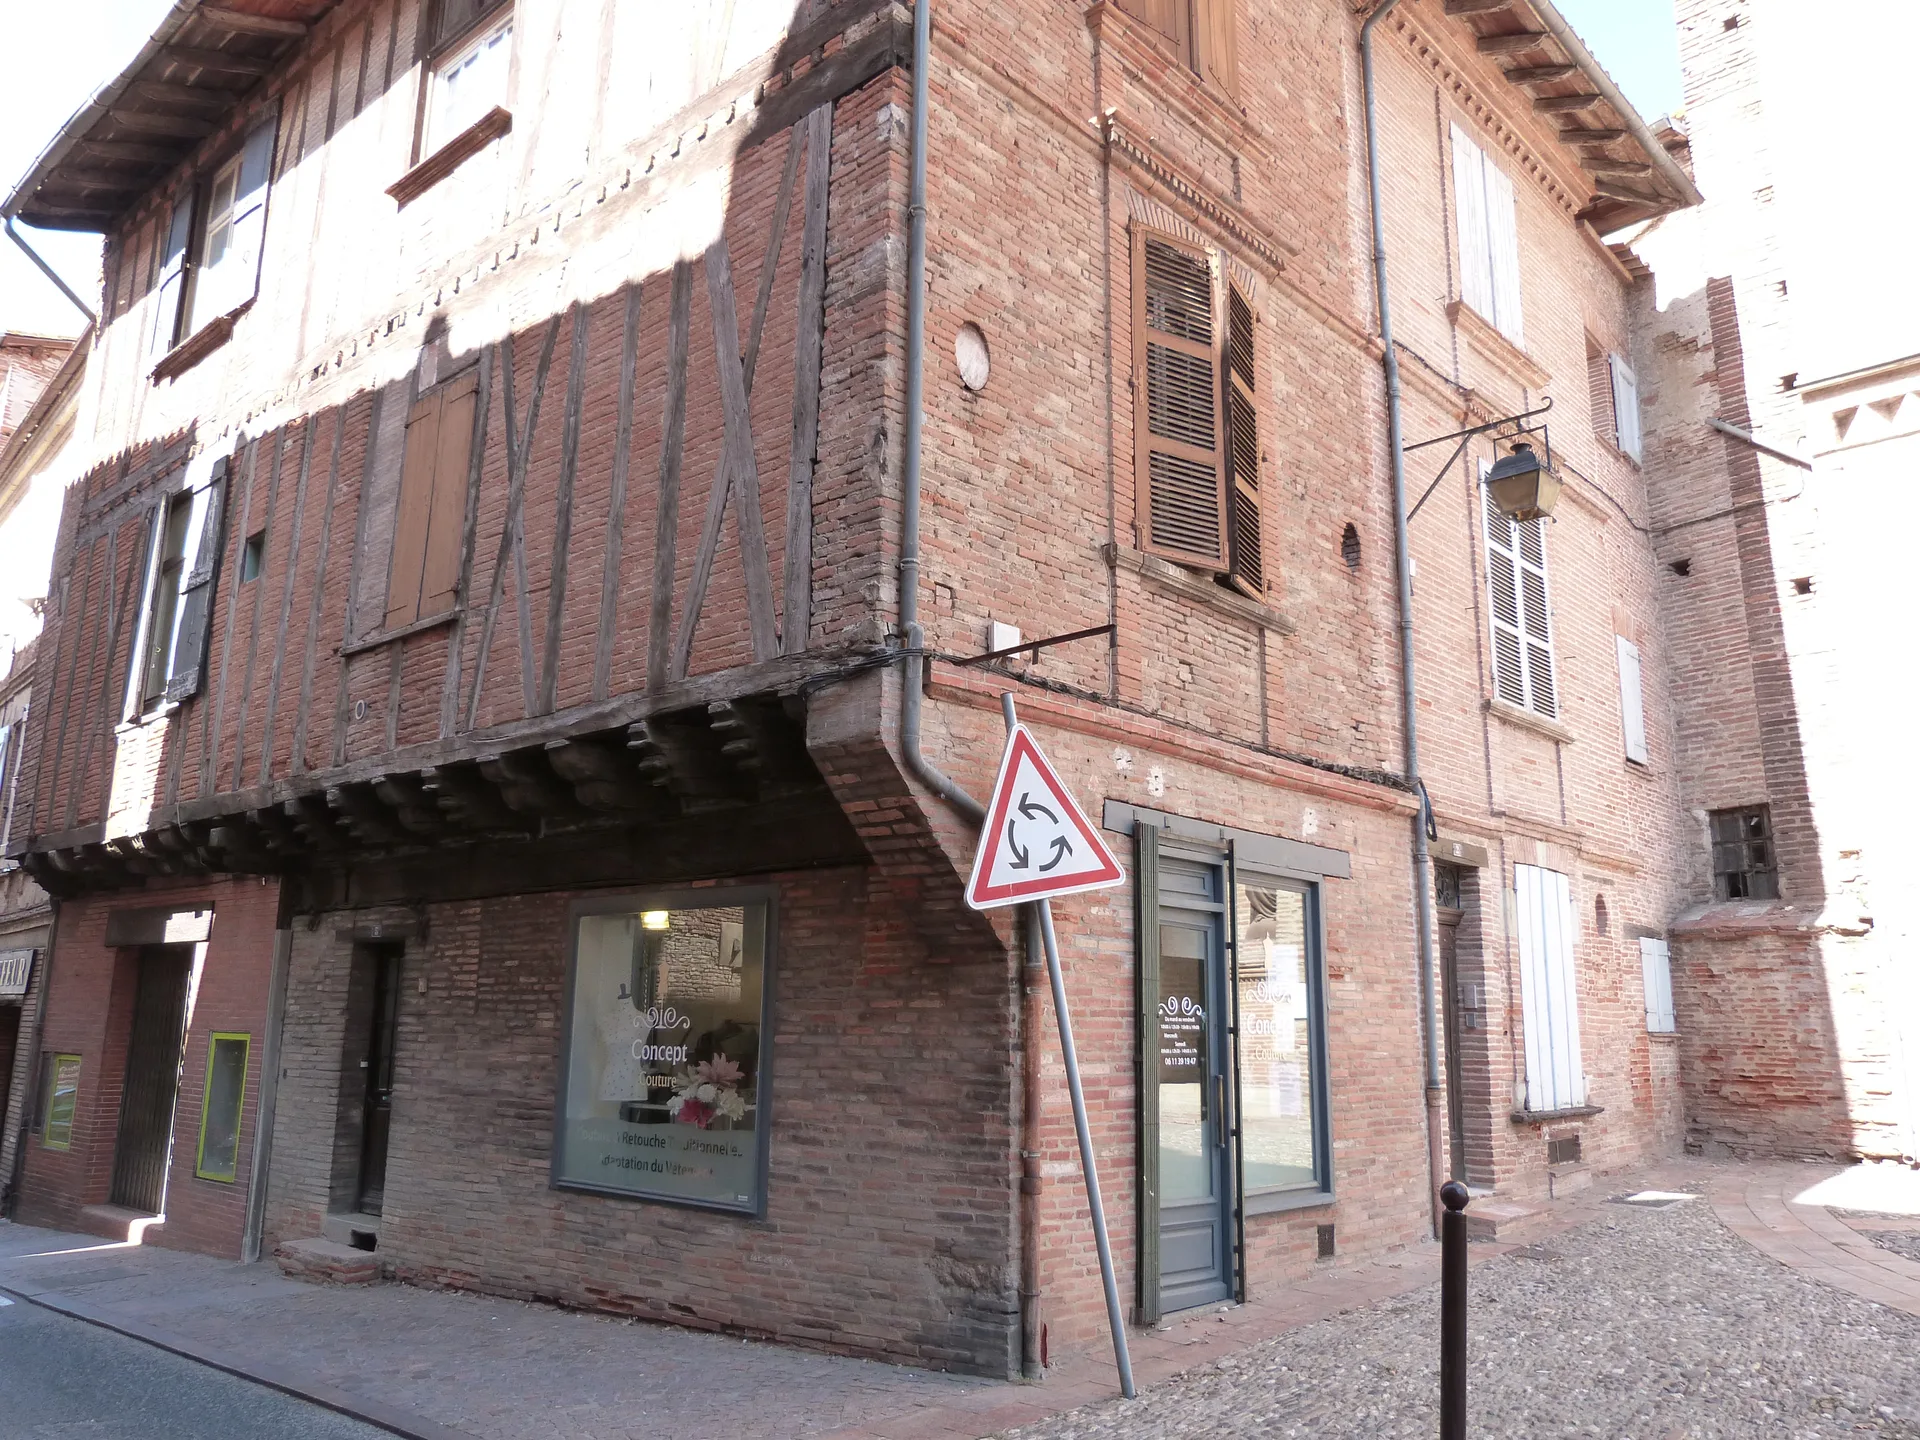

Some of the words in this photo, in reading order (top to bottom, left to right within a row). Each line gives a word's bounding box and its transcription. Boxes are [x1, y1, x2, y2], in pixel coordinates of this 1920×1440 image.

[631, 1039, 688, 1065] Concept
[1164, 1057, 1171, 1065] 06
[1171, 1057, 1177, 1065] 11
[640, 1071, 677, 1088] Couture
[622, 1131, 666, 1149] Retouche
[650, 1158, 664, 1173] du
